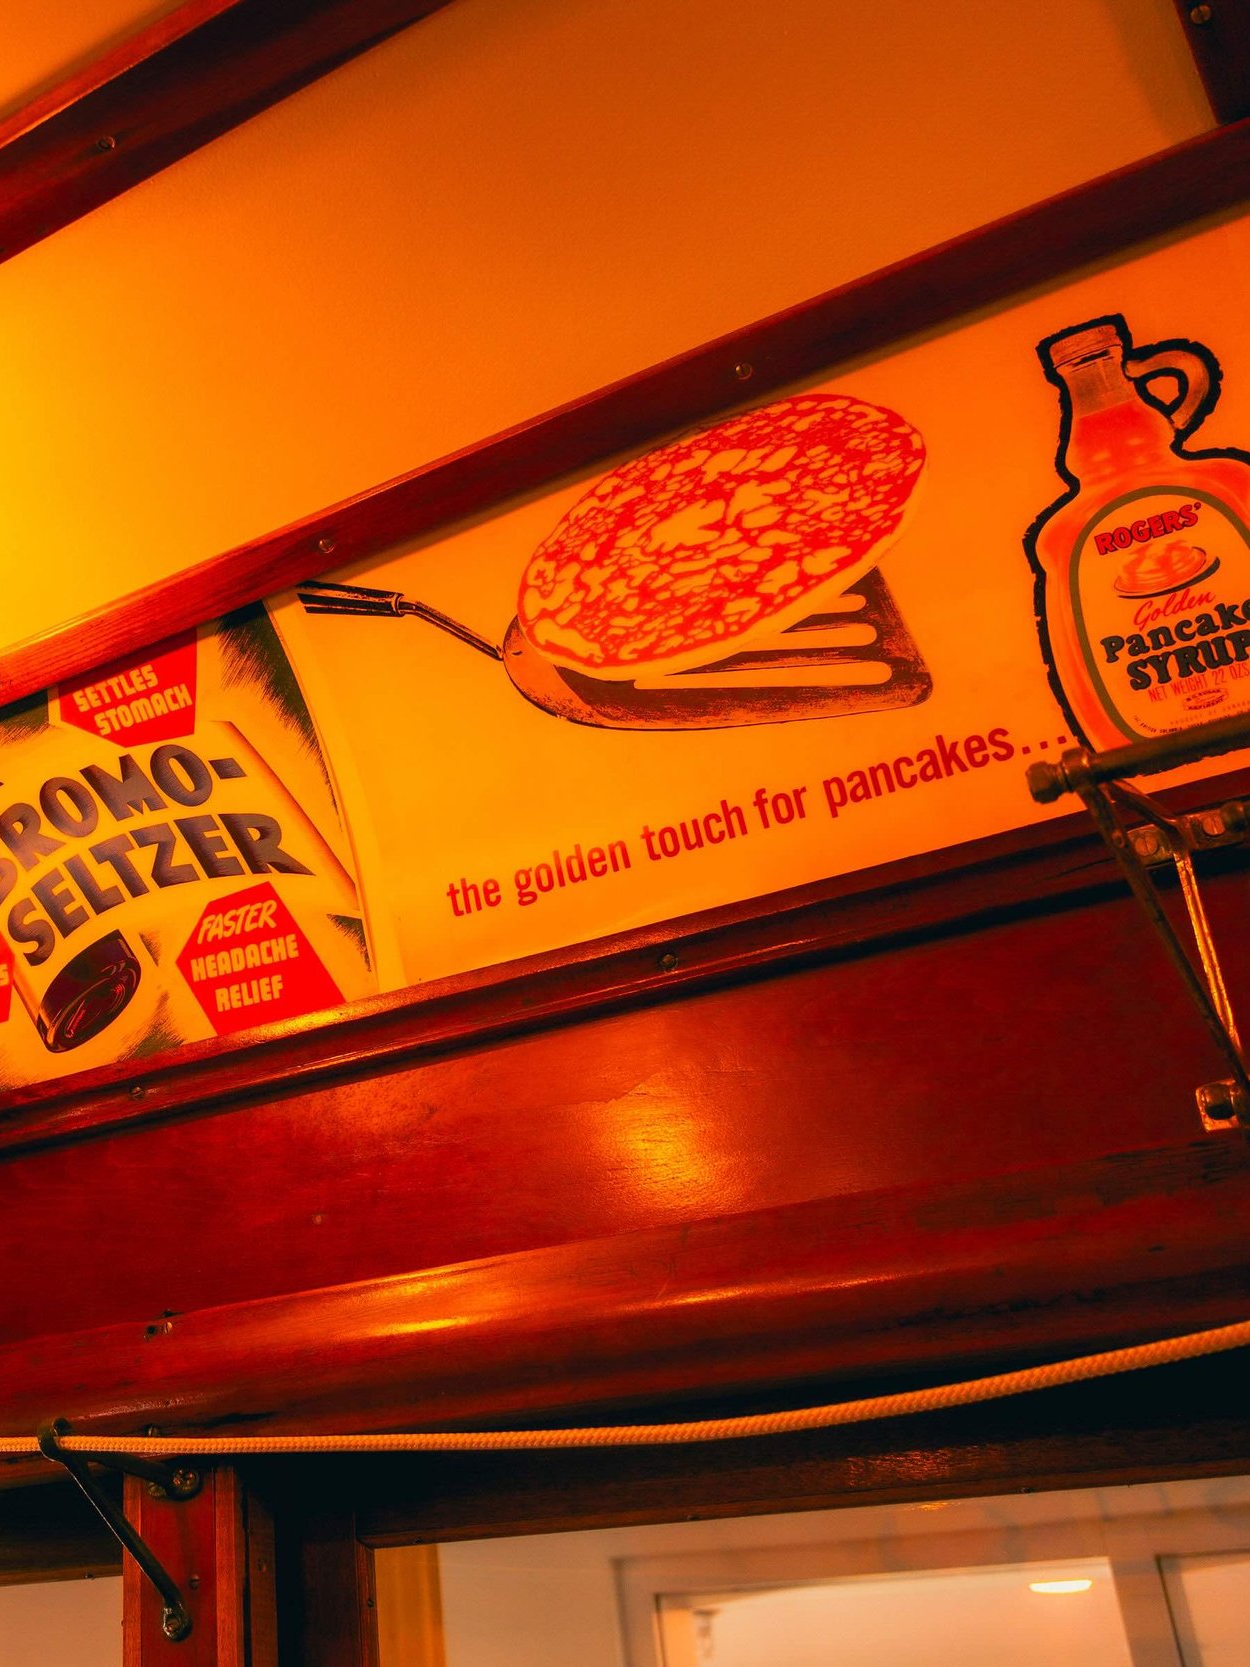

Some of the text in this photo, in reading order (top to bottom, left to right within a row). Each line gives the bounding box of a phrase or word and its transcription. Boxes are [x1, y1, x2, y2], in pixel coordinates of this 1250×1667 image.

[1133, 588, 1215, 632] Golden
[1126, 629, 1250, 691] SYRUP
[72, 664, 159, 712] SETTLES
[1148, 685, 1168, 703] NET
[1170, 674, 1208, 696] WEIGHT
[1212, 668, 1227, 686] 22
[94, 684, 193, 736] STOMACH
[446, 878, 502, 917] the
[514, 839, 631, 906] golden
[640, 799, 748, 861] touch
[753, 784, 808, 830] for
[6, 813, 316, 967] SELTZER
[197, 899, 278, 945] FASTER
[190, 934, 299, 982] HEADACHE
[215, 975, 284, 1012] RELIEF
